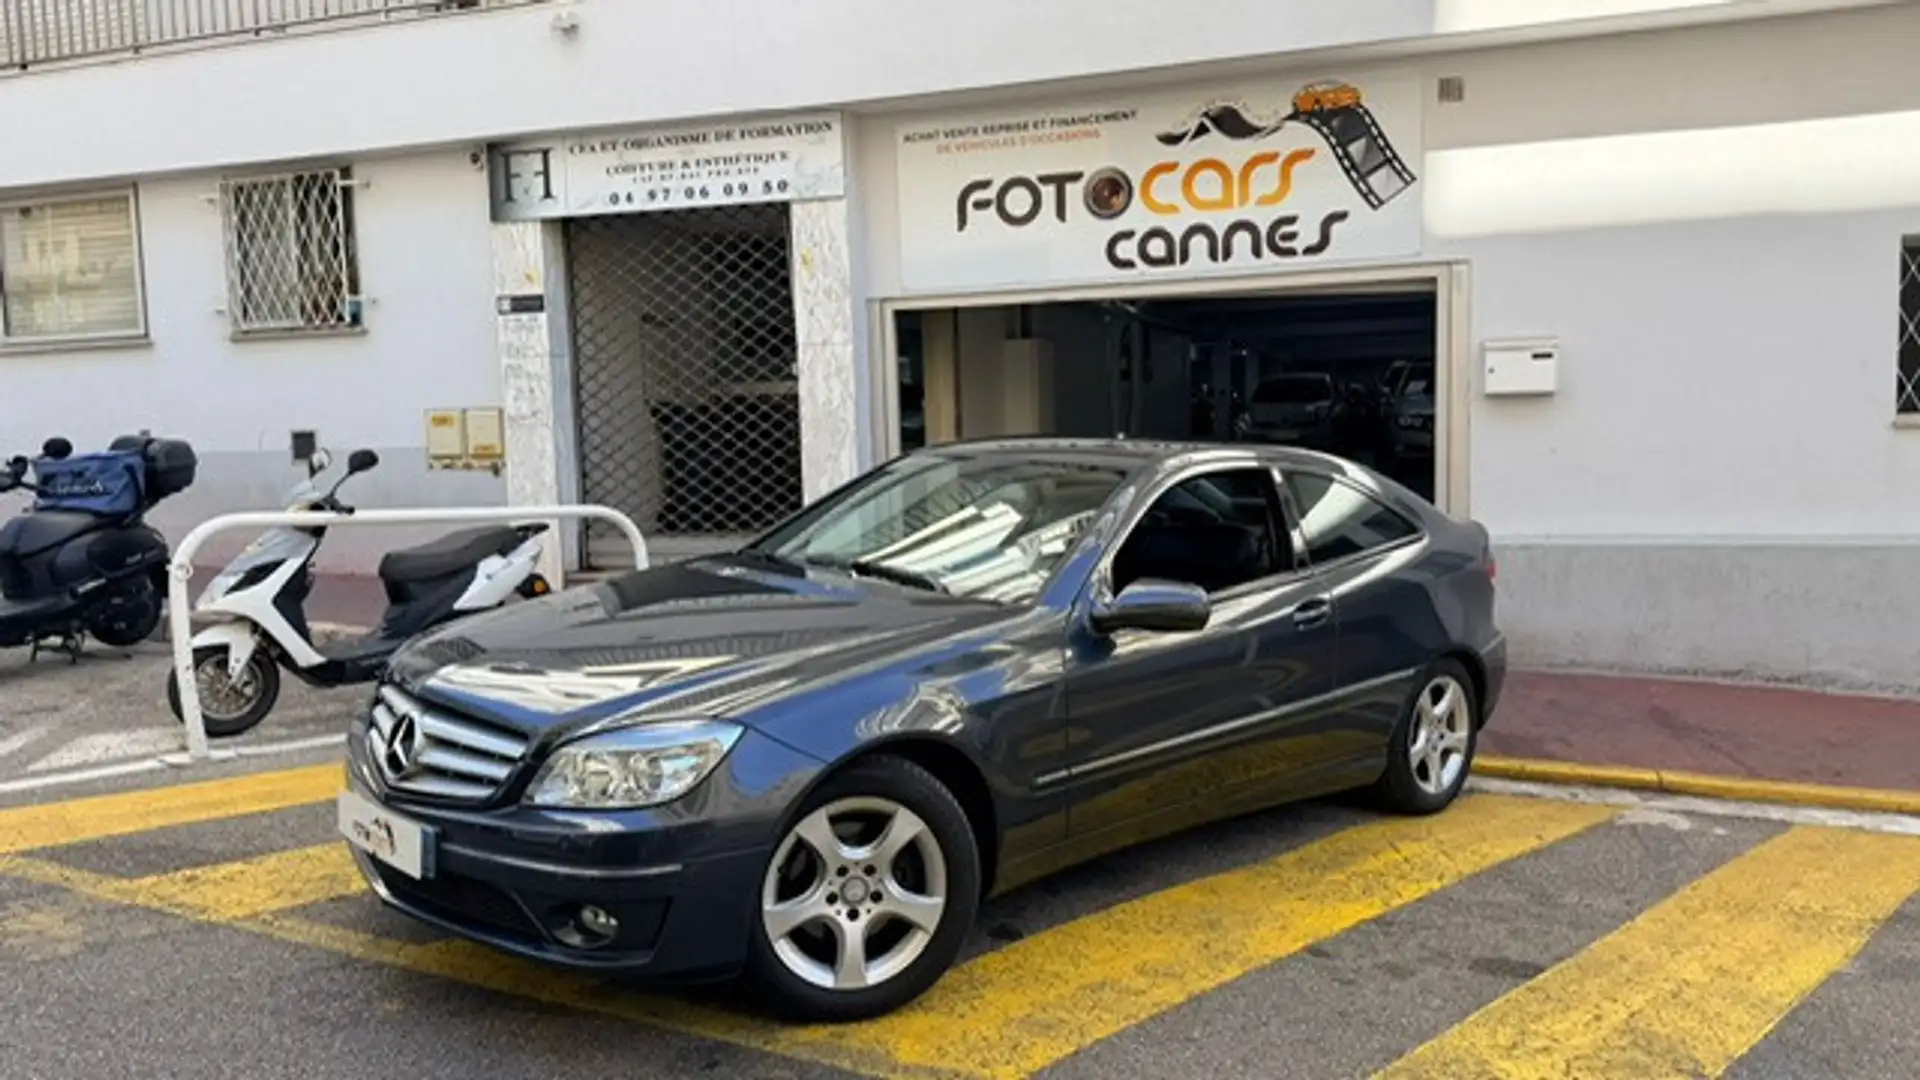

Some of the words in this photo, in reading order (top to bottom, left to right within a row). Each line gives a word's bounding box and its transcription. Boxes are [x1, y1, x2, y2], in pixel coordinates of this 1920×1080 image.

[600, 139, 618, 152] ET
[623, 130, 706, 149] ORGANISME
[714, 128, 735, 143] DE
[740, 120, 832, 140] FORMATION
[902, 128, 940, 145] ACHAT
[942, 125, 979, 140] VENTE
[982, 120, 1030, 137] REPRISE
[1032, 117, 1047, 131] ET
[1049, 108, 1138, 130] FINANCEMENT
[936, 142, 953, 155] DE
[605, 160, 675, 176] COIFFURE
[680, 158, 691, 170] &
[608, 190, 634, 206] 04
[648, 187, 671, 202] 97
[684, 185, 710, 200] 06
[723, 181, 748, 197] 09
[762, 178, 789, 195] 50
